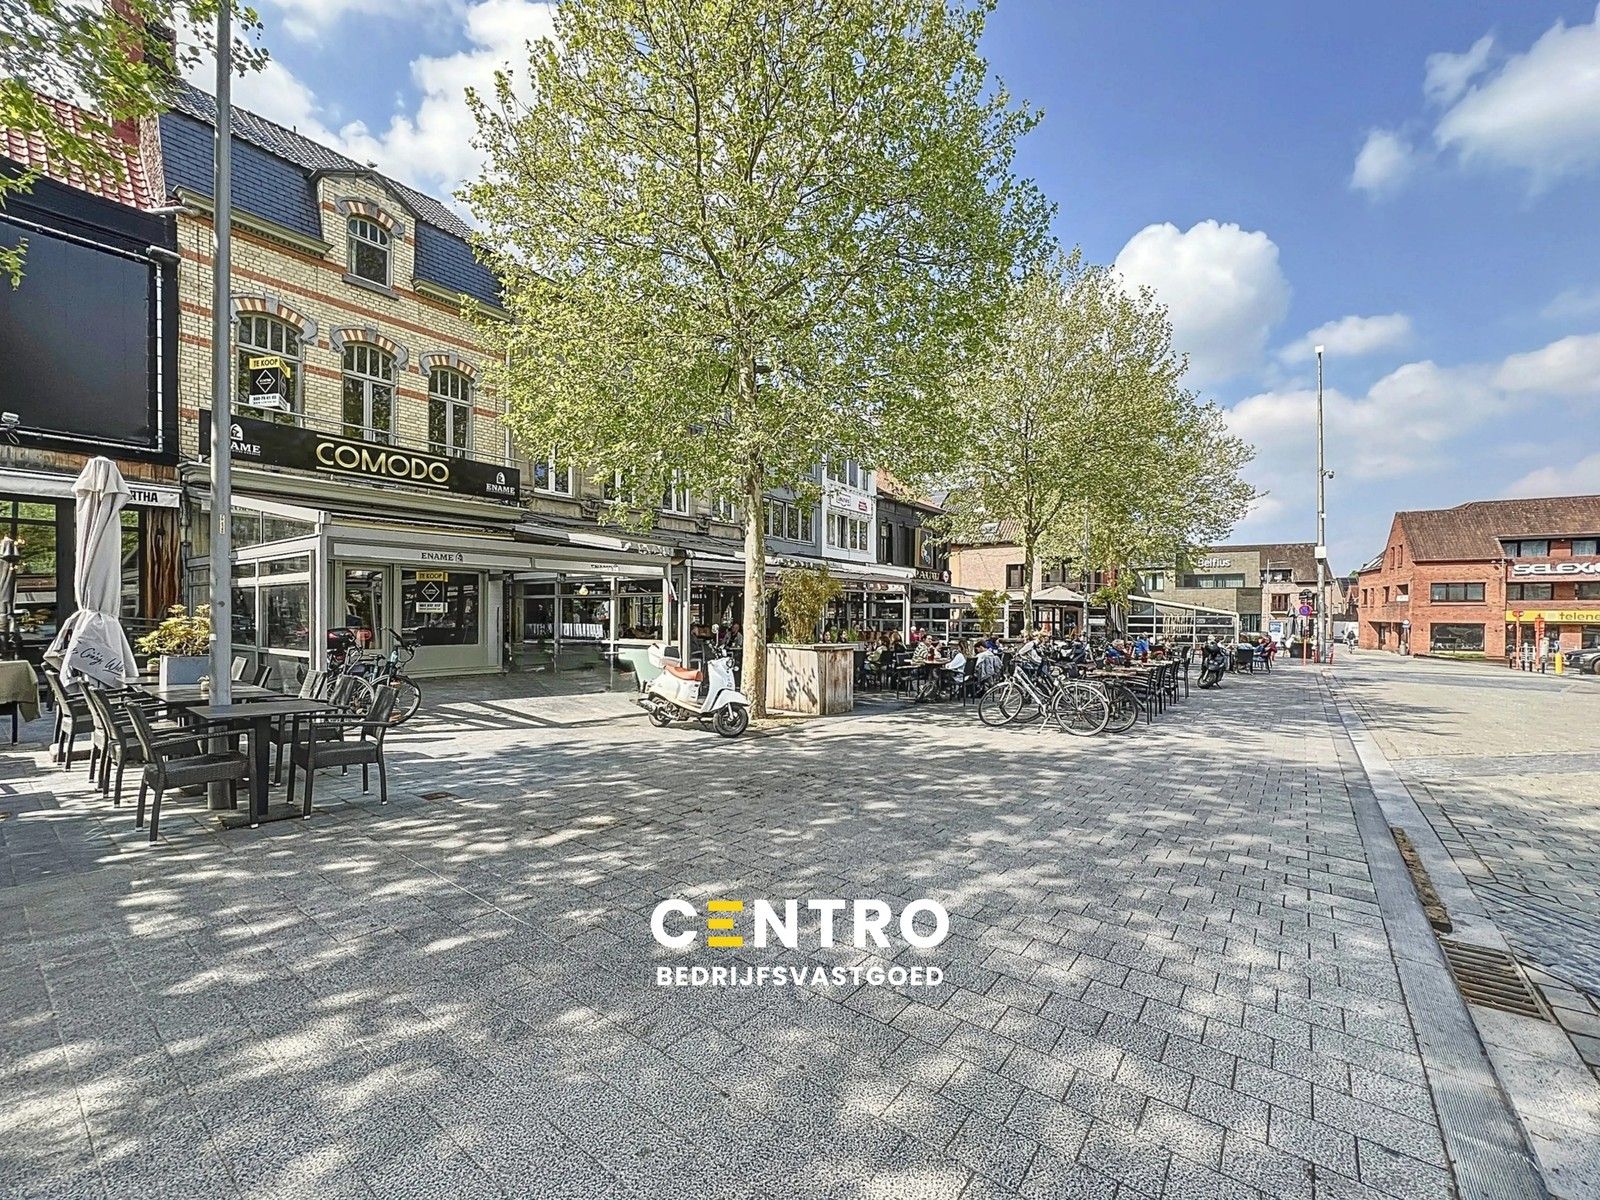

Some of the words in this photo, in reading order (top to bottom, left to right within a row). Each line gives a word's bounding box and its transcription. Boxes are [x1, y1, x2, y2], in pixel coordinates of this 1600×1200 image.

[230, 441, 261, 455] AME
[316, 442, 450, 483] COMODO
[485, 483, 516, 495] ENAME
[130, 490, 158, 502] RTHA
[421, 552, 454, 561] ENAME
[1197, 557, 1232, 569] Belfius
